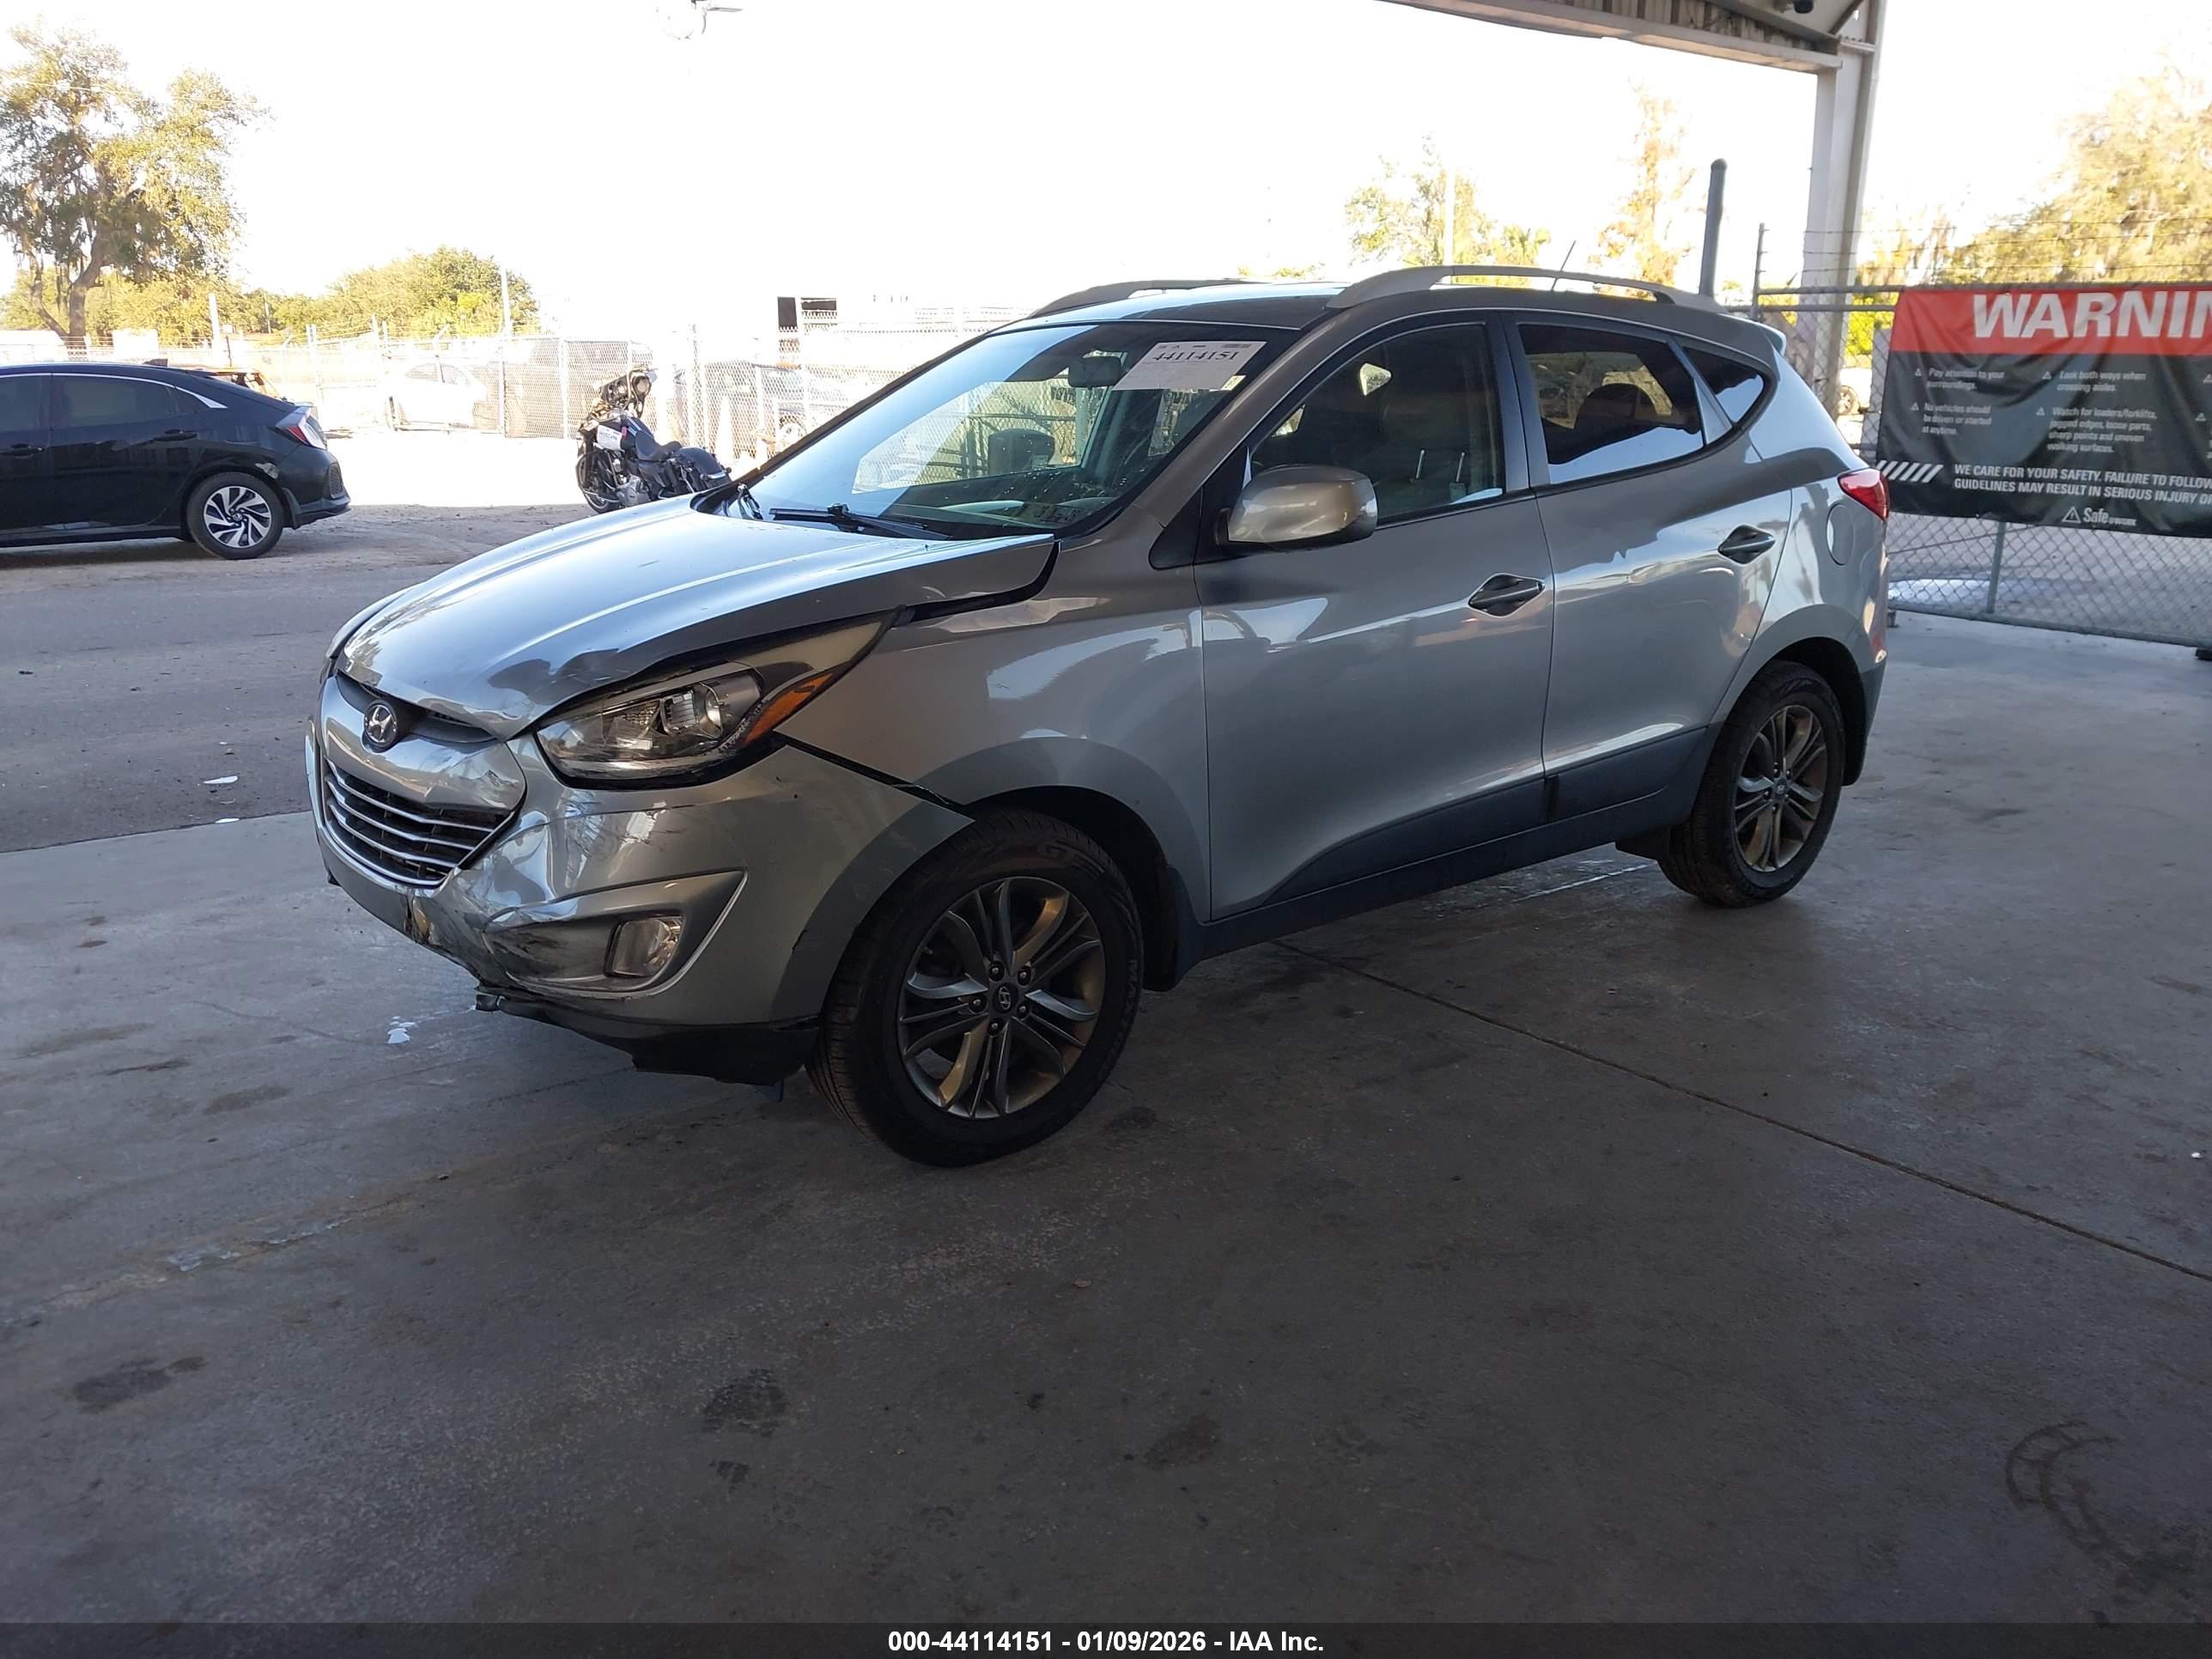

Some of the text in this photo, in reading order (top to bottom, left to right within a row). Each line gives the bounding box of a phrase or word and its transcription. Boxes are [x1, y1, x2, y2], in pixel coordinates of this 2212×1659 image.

[1954, 464, 1972, 475] WE
[1973, 465, 2001, 477] CARE
[2002, 466, 2024, 478] FOR
[2027, 467, 2058, 479] YOUR
[2060, 469, 2102, 482] SAFETY.
[2104, 471, 2149, 485] FAILURE
[2151, 474, 2167, 486] TO
[1954, 478, 2016, 492] GUIDELINES
[2018, 482, 2045, 493] MAY
[2046, 483, 2087, 495] RESULT
[2088, 485, 2101, 496] IN
[2104, 486, 2152, 500] SERIOUS
[2154, 490, 2198, 504] INJURY
